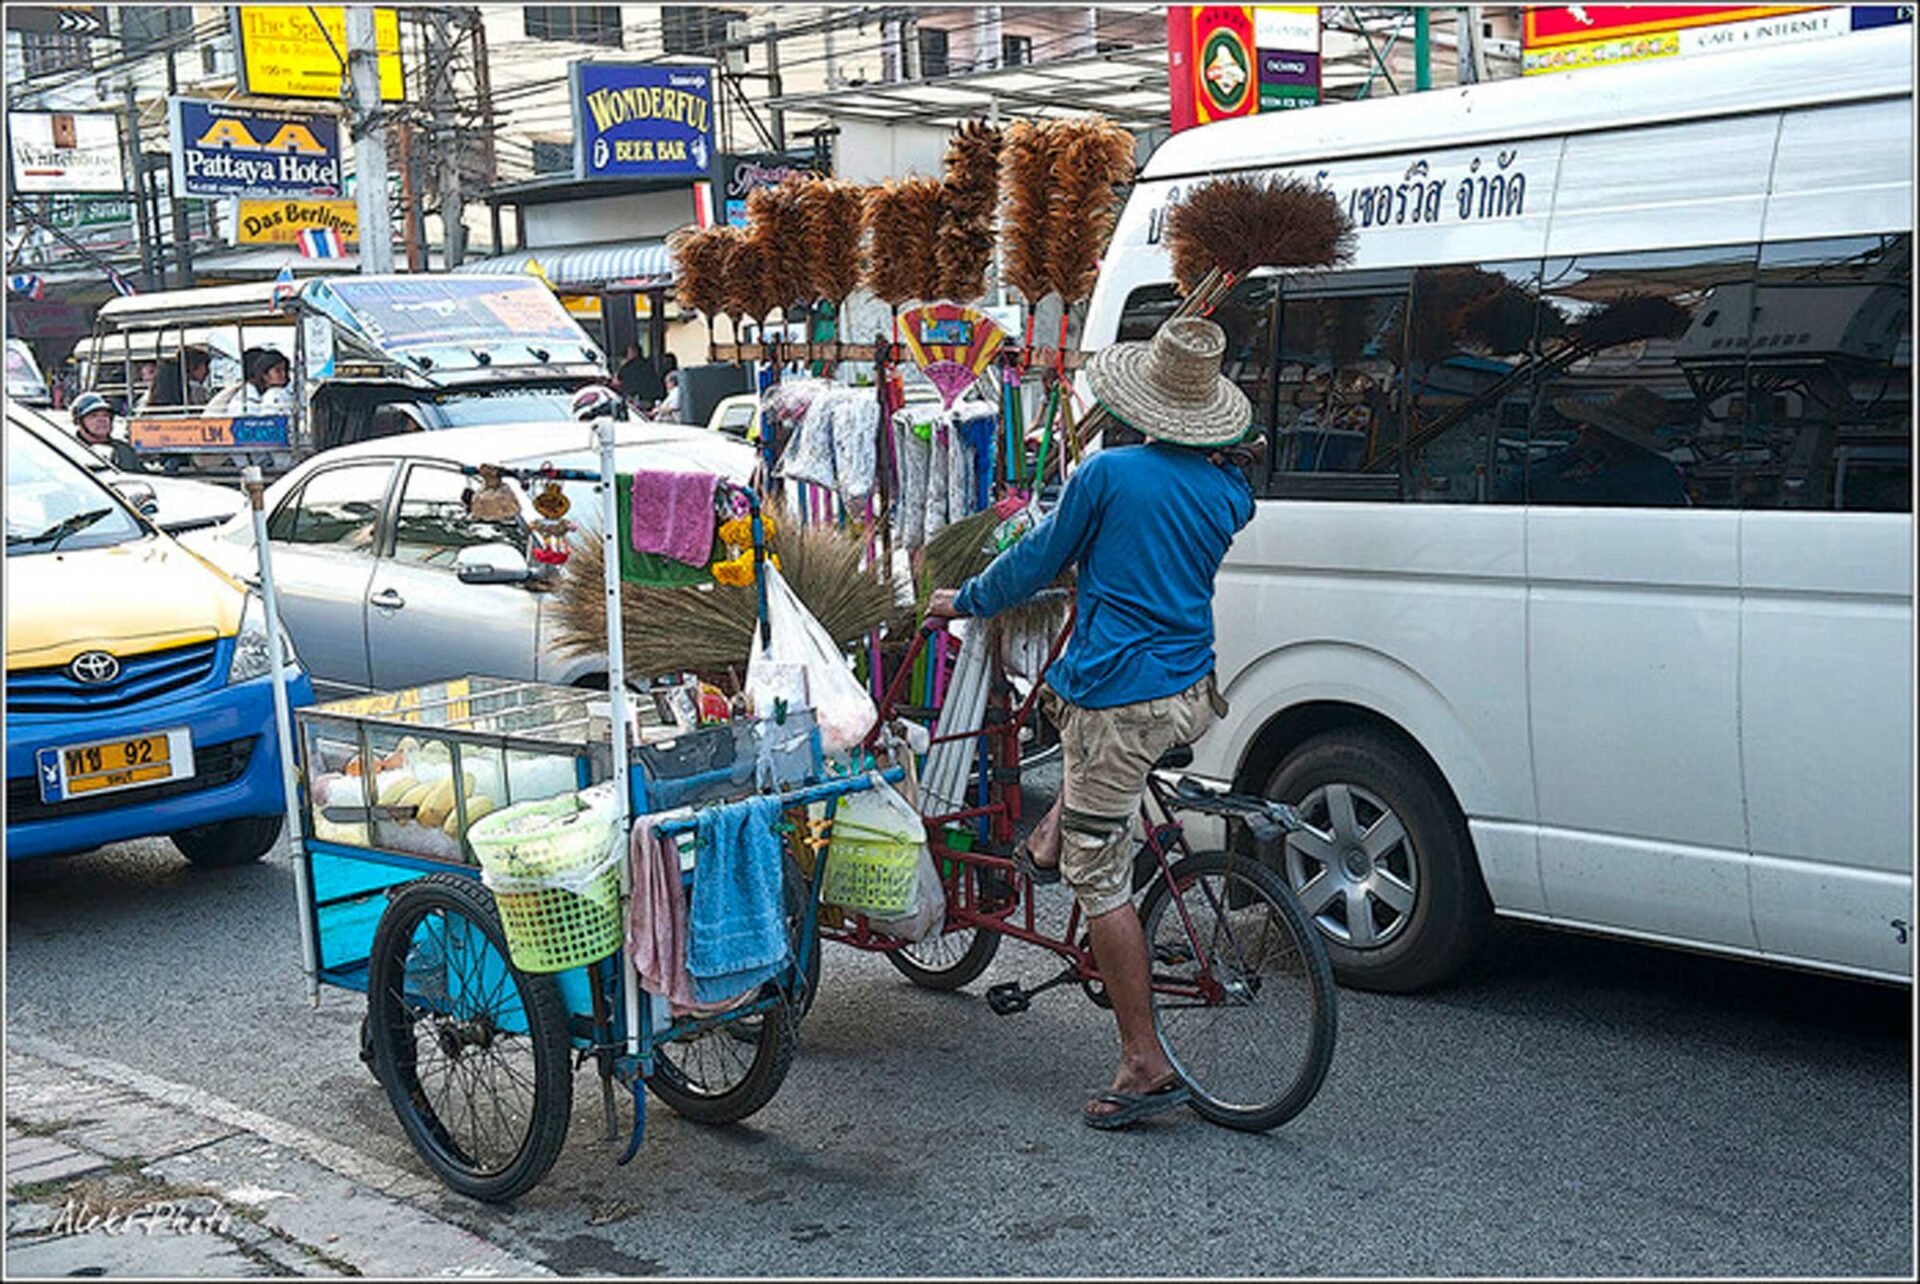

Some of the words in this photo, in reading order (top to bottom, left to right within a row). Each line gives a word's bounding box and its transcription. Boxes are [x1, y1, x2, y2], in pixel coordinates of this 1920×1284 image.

[245, 12, 284, 34] The
[1757, 18, 1829, 39] INTERNET
[586, 87, 710, 133] WONDERFUL
[615, 141, 655, 161] BEER
[657, 141, 687, 161] BAR
[186, 150, 275, 184] Pattaya
[279, 155, 338, 184] Hotel
[1457, 150, 1526, 220] จำกัด
[243, 211, 283, 237] Das
[124, 739, 153, 765] 92
